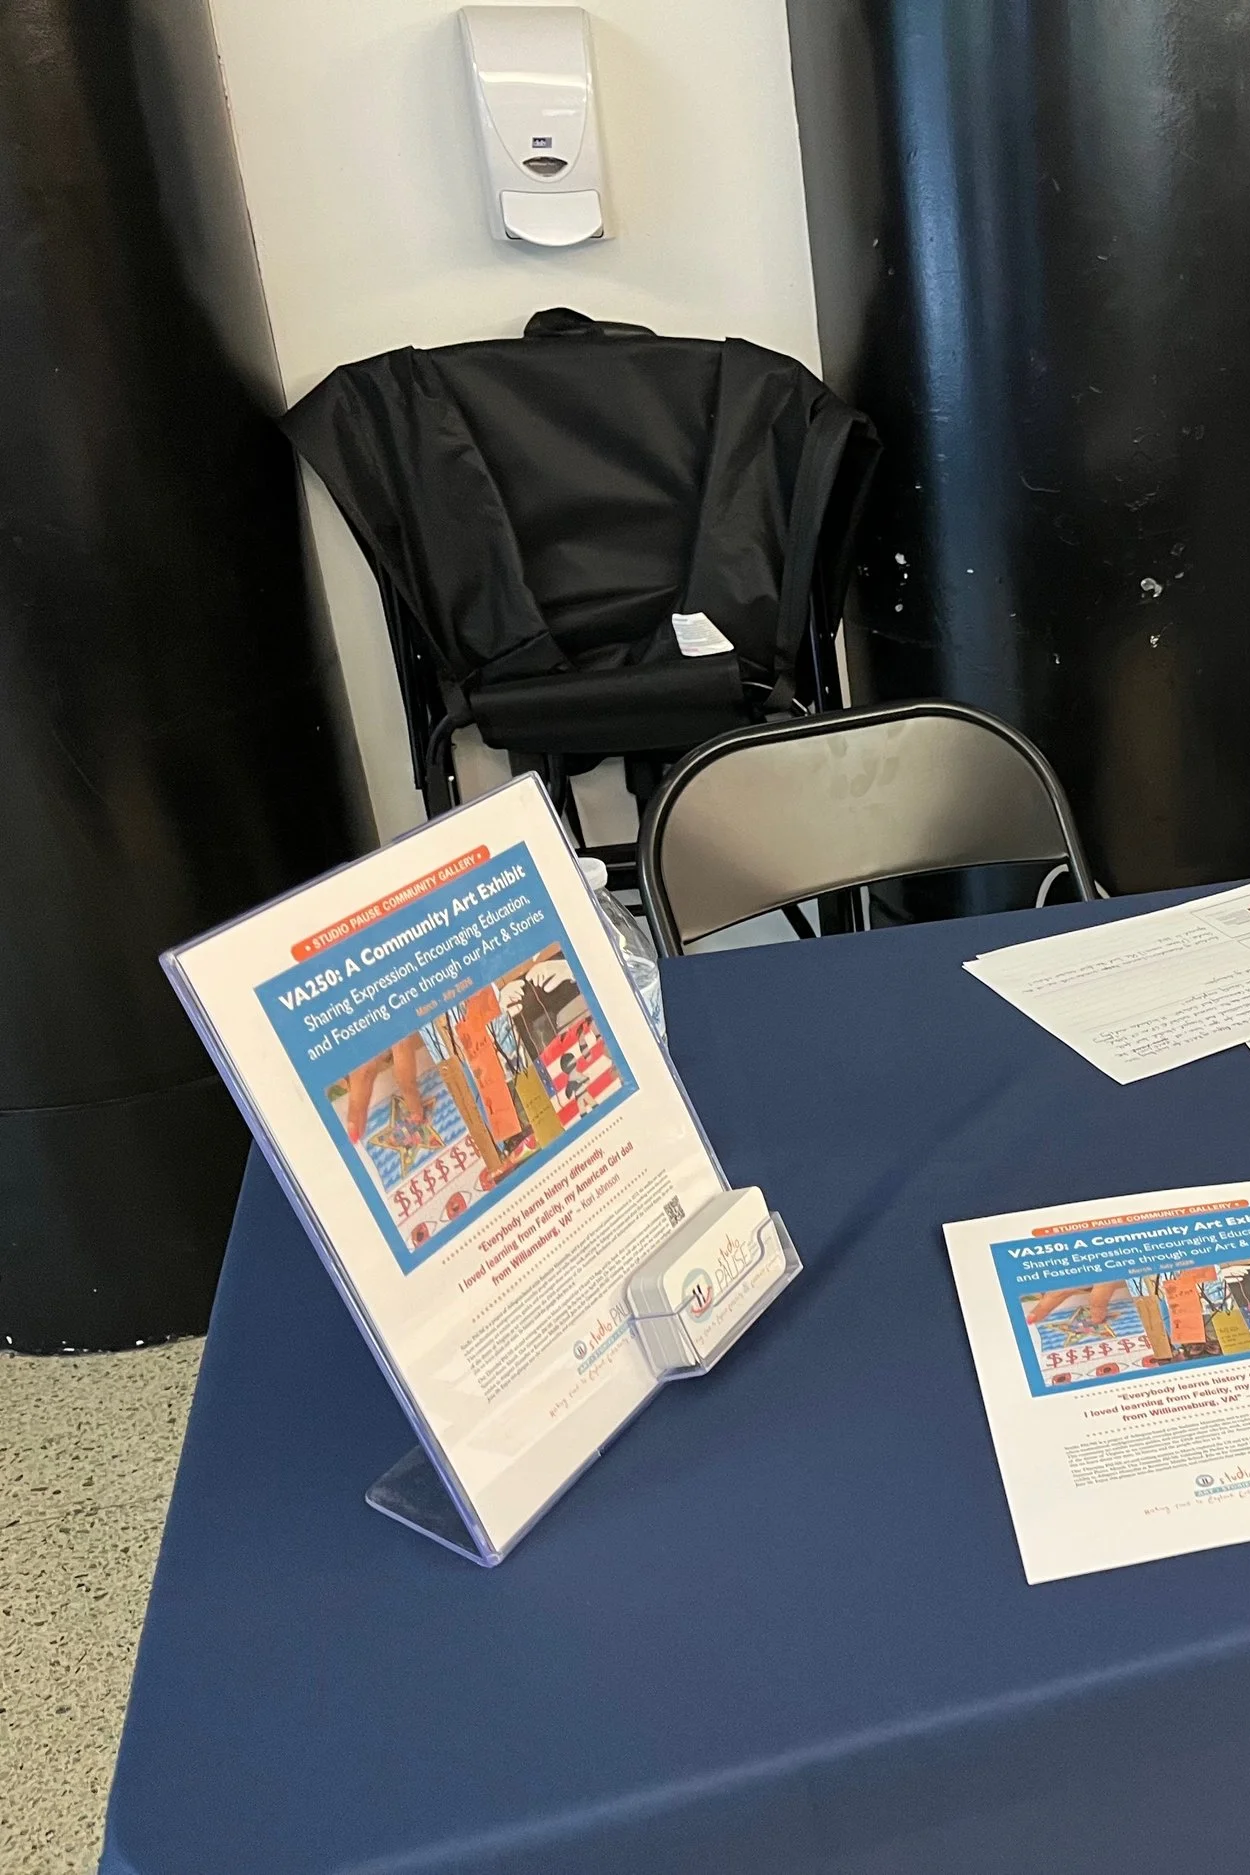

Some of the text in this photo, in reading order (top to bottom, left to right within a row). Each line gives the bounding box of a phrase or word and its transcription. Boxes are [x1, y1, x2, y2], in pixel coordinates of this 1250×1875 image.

[313, 856, 474, 948] STUDIO PAUSE COMMUNITY GALLERY
[280, 866, 525, 1009] VA250: A Community Art Exhibit
[304, 896, 530, 1031] Sharing Expression, Encouraging Education,
[308, 910, 544, 1060] and Fostering Care through our Art & Stories
[415, 998, 437, 1018] March
[458, 1142, 633, 1293] I loved learning from Felicity, my American Girl doll
[521, 1197, 544, 1219] learns
[544, 1177, 569, 1200] history
[1052, 1202, 1231, 1233] STUDIO PAUSE COMMUNITY GALLERY
[492, 1267, 511, 1286] from
[510, 1228, 560, 1268] Williamsburg,
[581, 1194, 595, 1209] Kori
[595, 1174, 620, 1198] Johnson
[717, 1232, 740, 1267] studio
[1008, 1243, 1068, 1257] VA250:
[1074, 1240, 1088, 1249] A
[1092, 1226, 1188, 1245] Community
[1194, 1220, 1222, 1231] Art
[714, 1239, 748, 1293] PAUSE
[1016, 1272, 1039, 1282] and
[1043, 1264, 1102, 1278] Fostering
[1104, 1259, 1135, 1268] Care
[1139, 1250, 1187, 1263] through
[1191, 1246, 1211, 1255] our
[1215, 1243, 1236, 1251] Art
[1023, 1258, 1069, 1269] Sharing
[1072, 1247, 1142, 1262] Expression,
[1144, 1235, 1217, 1251] Encouraging
[1178, 1381, 1209, 1390] learns
[1212, 1374, 1245, 1384] history
[1090, 1406, 1118, 1416] loved
[1121, 1400, 1164, 1411] learning
[1166, 1394, 1190, 1403] from
[1193, 1388, 1232, 1398] Felicity,
[1122, 1413, 1147, 1421] from
[1149, 1400, 1218, 1416] Williamsburg,
